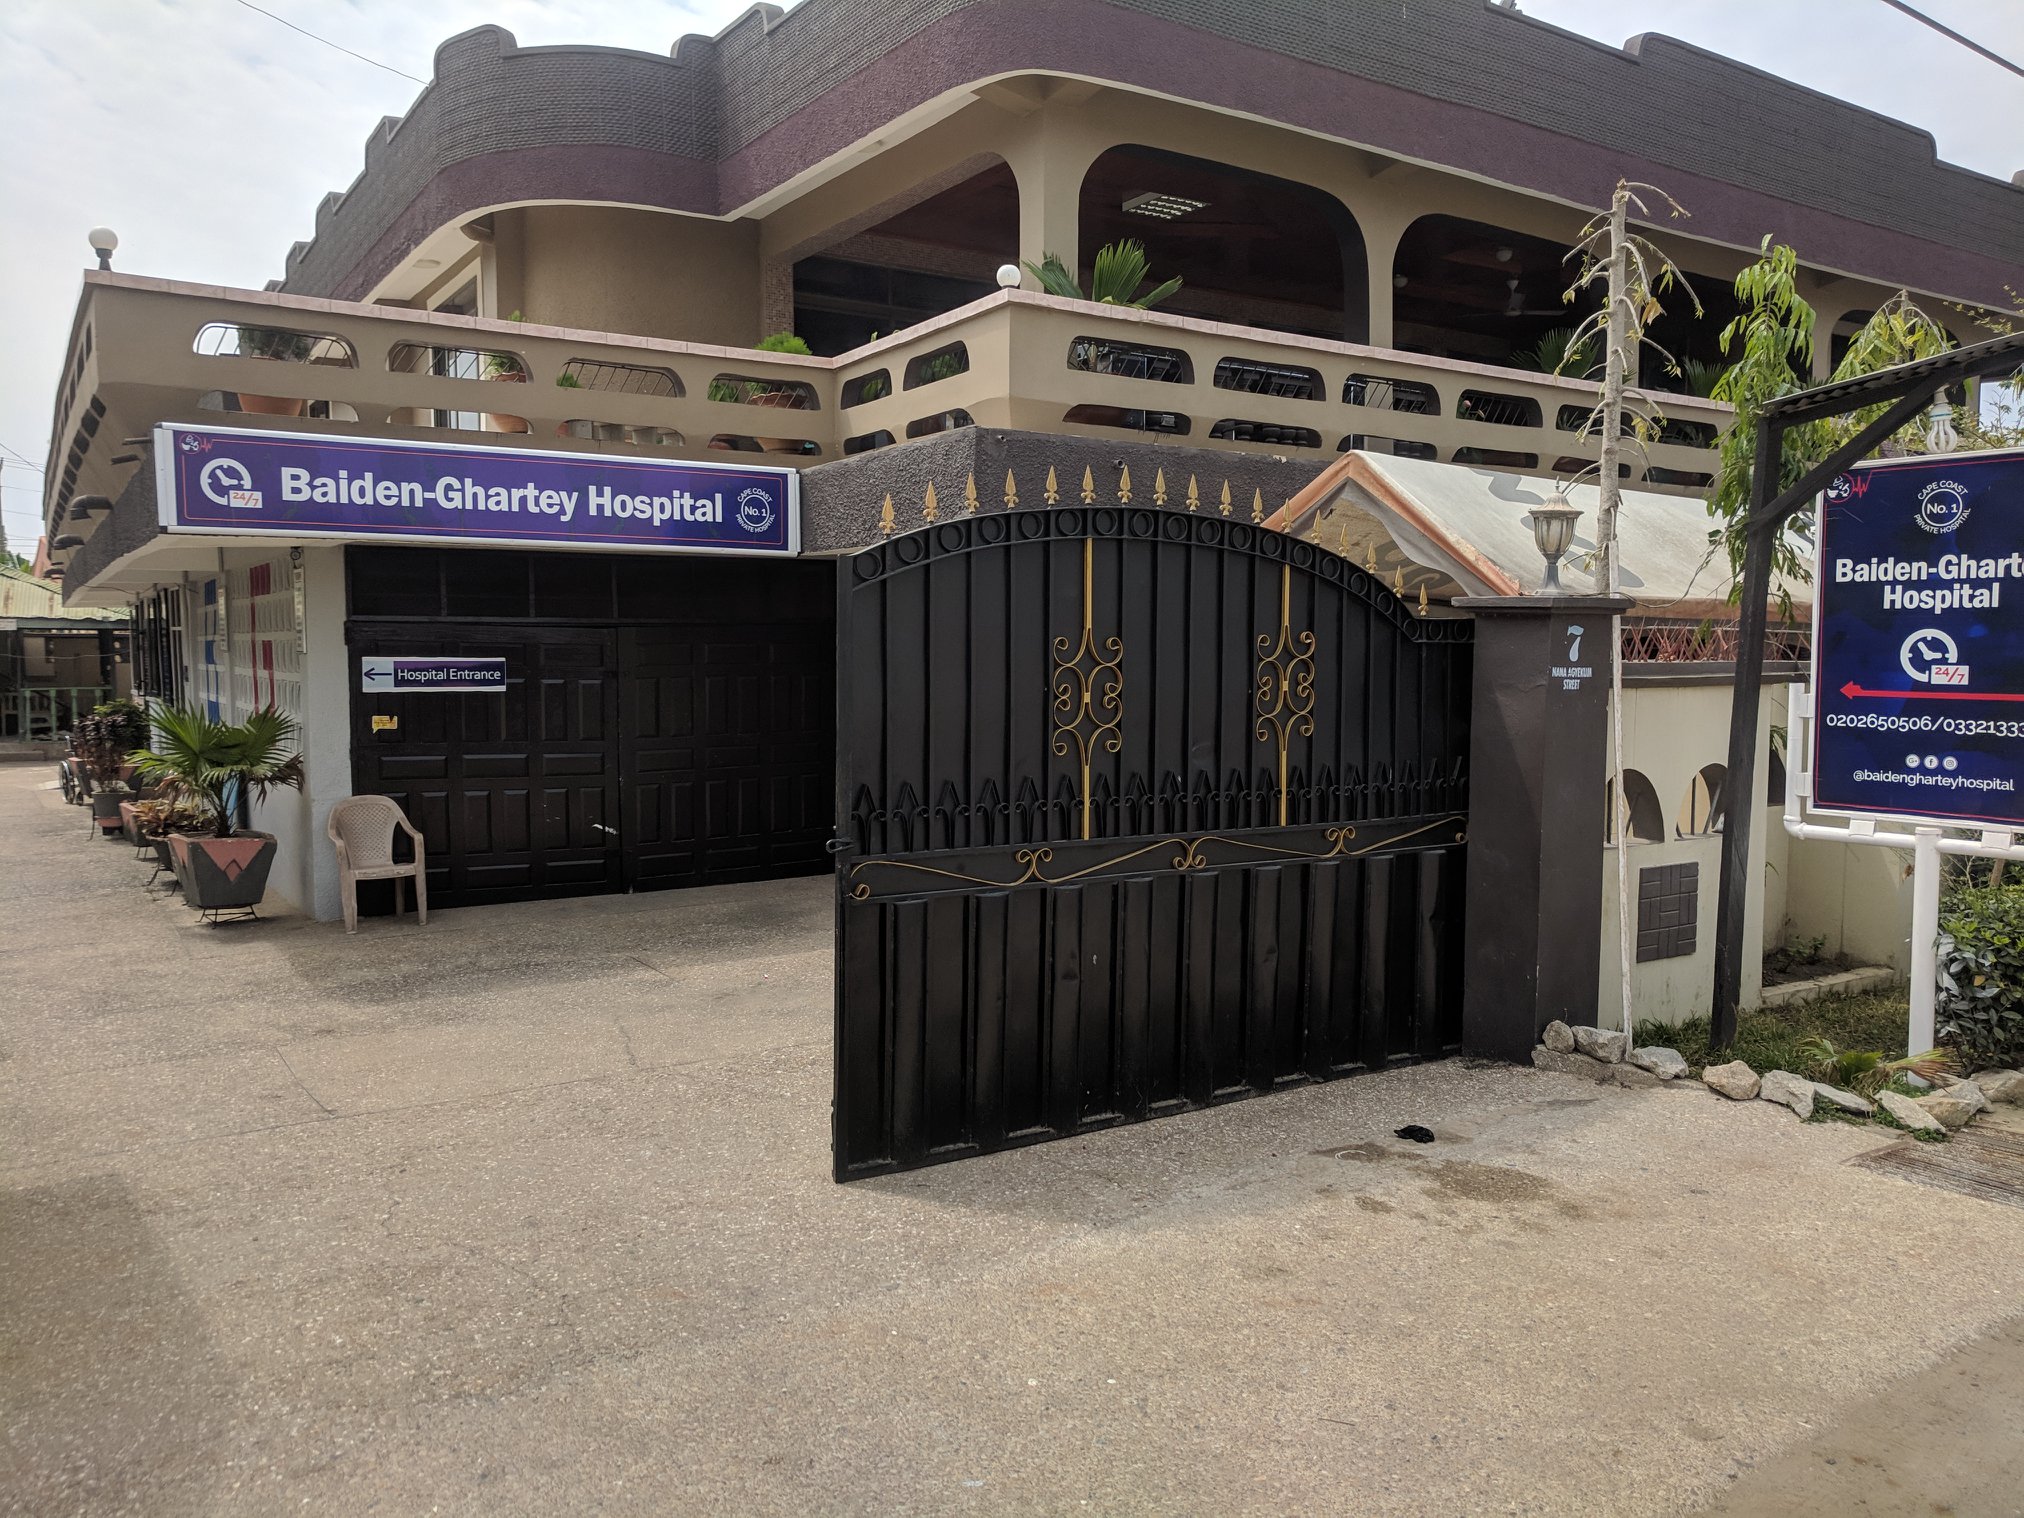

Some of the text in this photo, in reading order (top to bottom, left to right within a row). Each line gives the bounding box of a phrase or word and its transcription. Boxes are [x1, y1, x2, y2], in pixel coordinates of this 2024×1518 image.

[232, 491, 260, 507] 24/7
[281, 466, 722, 526] Baiden-Ghartey Hospital
[737, 487, 773, 502] CAPE COAST
[1917, 480, 1969, 500] CAPE COAST
[744, 505, 767, 517] No. 1
[1926, 502, 1958, 515] No. 1
[735, 513, 776, 533] PRIVATE HOSPITAL
[1913, 507, 1971, 534] PRIVATE HOSPITAL
[1835, 552, 2024, 583] Baiden-Ghart
[1883, 582, 2000, 615] Hospital
[1567, 624, 1585, 662] 7
[397, 668, 502, 683] Hospital Entrance
[1551, 667, 1567, 678] NANA
[1934, 666, 1966, 683] 24/7
[1562, 679, 1581, 690] STREET
[1853, 769, 2015, 792] @baidengharteyhospital
